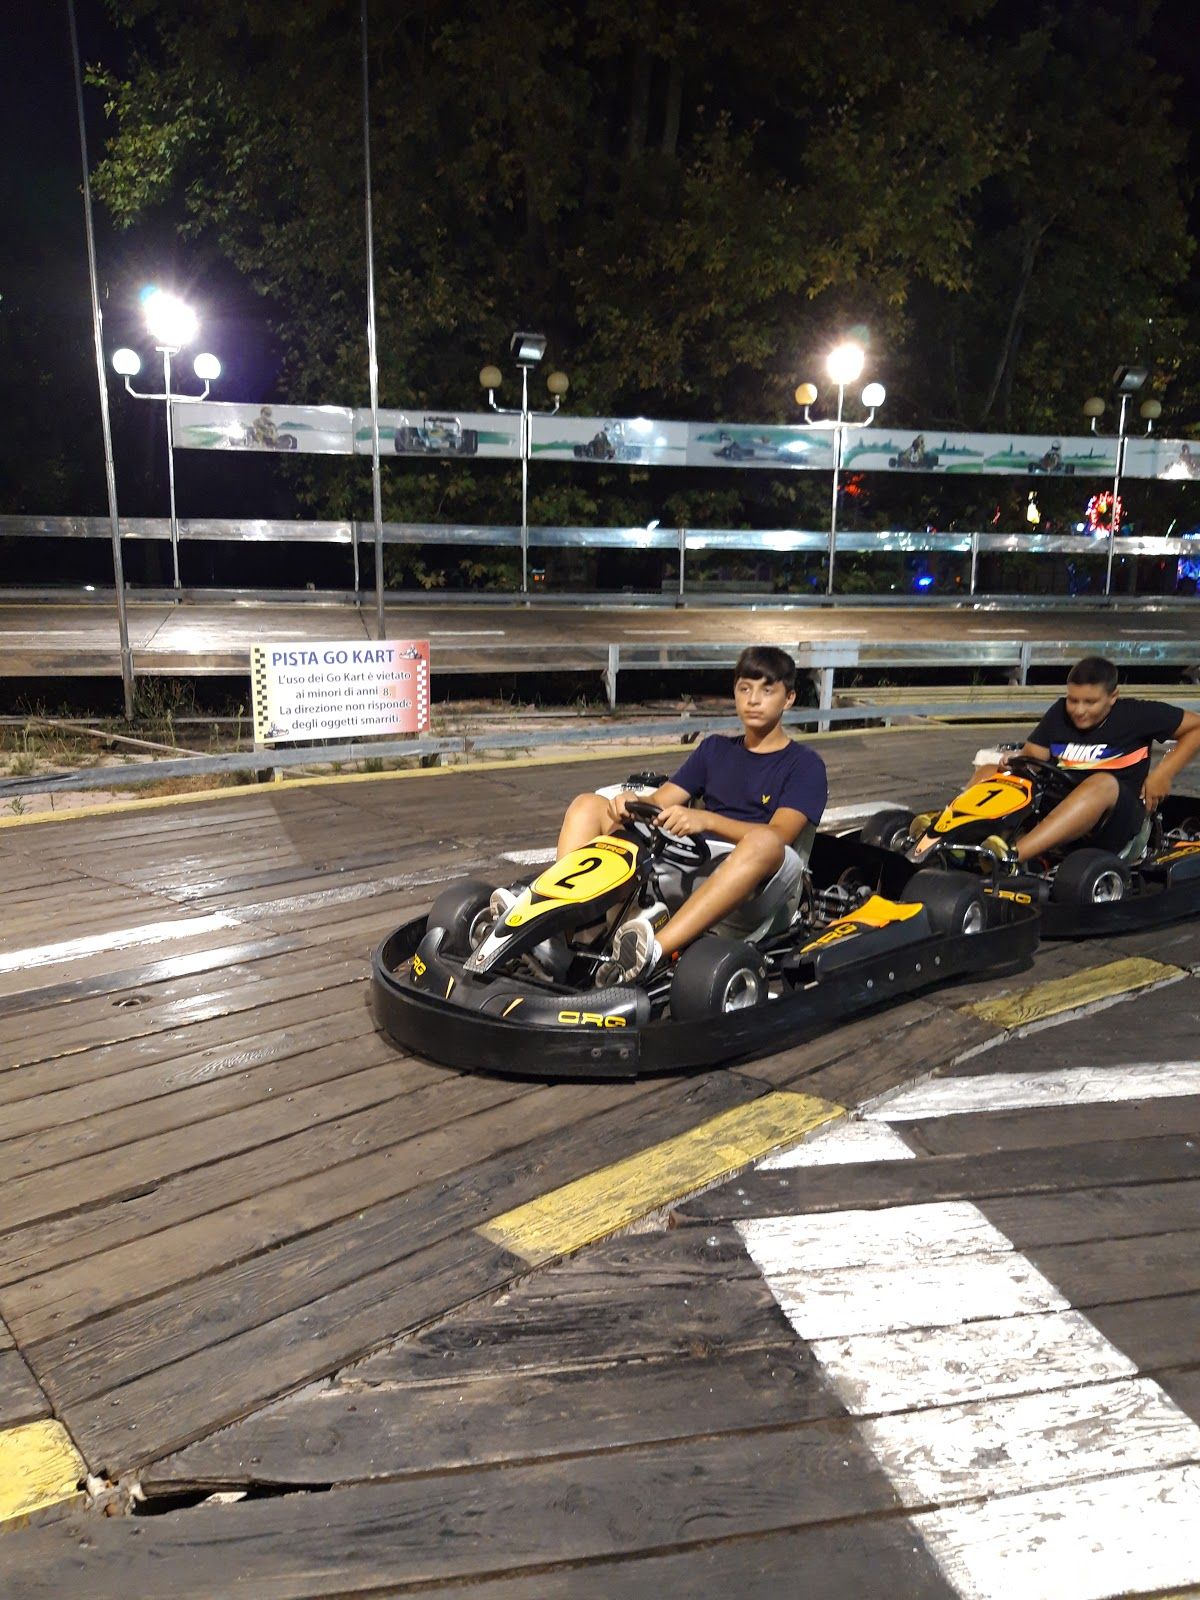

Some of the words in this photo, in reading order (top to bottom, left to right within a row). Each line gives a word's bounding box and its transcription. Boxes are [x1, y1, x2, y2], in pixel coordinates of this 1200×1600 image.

[272, 651, 318, 666] PISTA
[323, 650, 348, 664] GO
[353, 649, 395, 663] KART
[278, 674, 305, 685] L'uso
[307, 672, 324, 683] dei
[326, 672, 341, 682] Go
[344, 671, 365, 682] Kart
[376, 670, 411, 680] vietato
[296, 689, 305, 699] ai
[307, 688, 341, 698] minori
[344, 686, 354, 696] di
[356, 686, 378, 696] anni
[280, 705, 292, 715] La
[294, 702, 343, 714] direzione
[345, 702, 365, 711] non
[368, 700, 411, 713] risponde
[292, 718, 318, 730] degli
[320, 716, 358, 729] oggetti
[1062, 743, 1109, 761] NIKE
[976, 788, 1004, 807] 1
[554, 856, 602, 889] 2
[413, 953, 427, 976] RG
[558, 1010, 627, 1029] CRG
